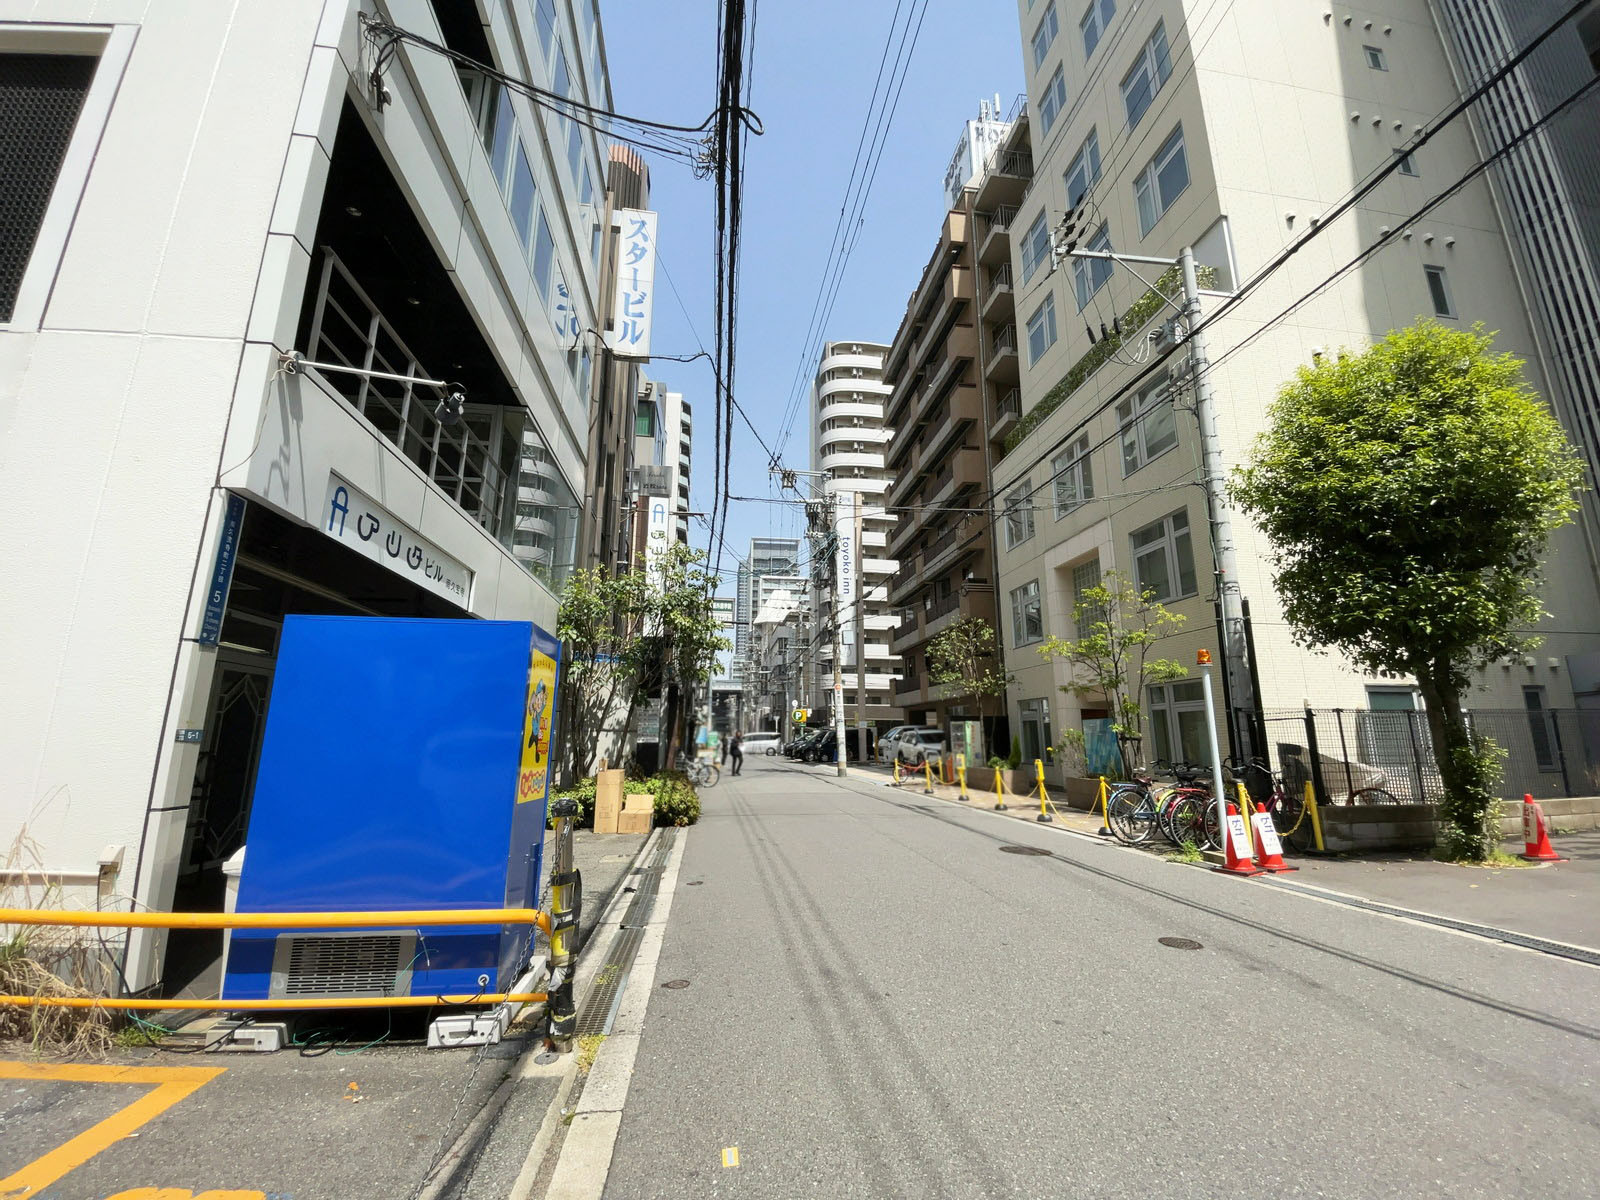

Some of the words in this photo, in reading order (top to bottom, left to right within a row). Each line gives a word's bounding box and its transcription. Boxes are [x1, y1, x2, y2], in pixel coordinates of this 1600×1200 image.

[617, 218, 649, 345] スタービル
[841, 536, 852, 574] toyoko
[843, 577, 852, 595] inn
[213, 590, 222, 603] 5
[795, 711, 802, 720] P
